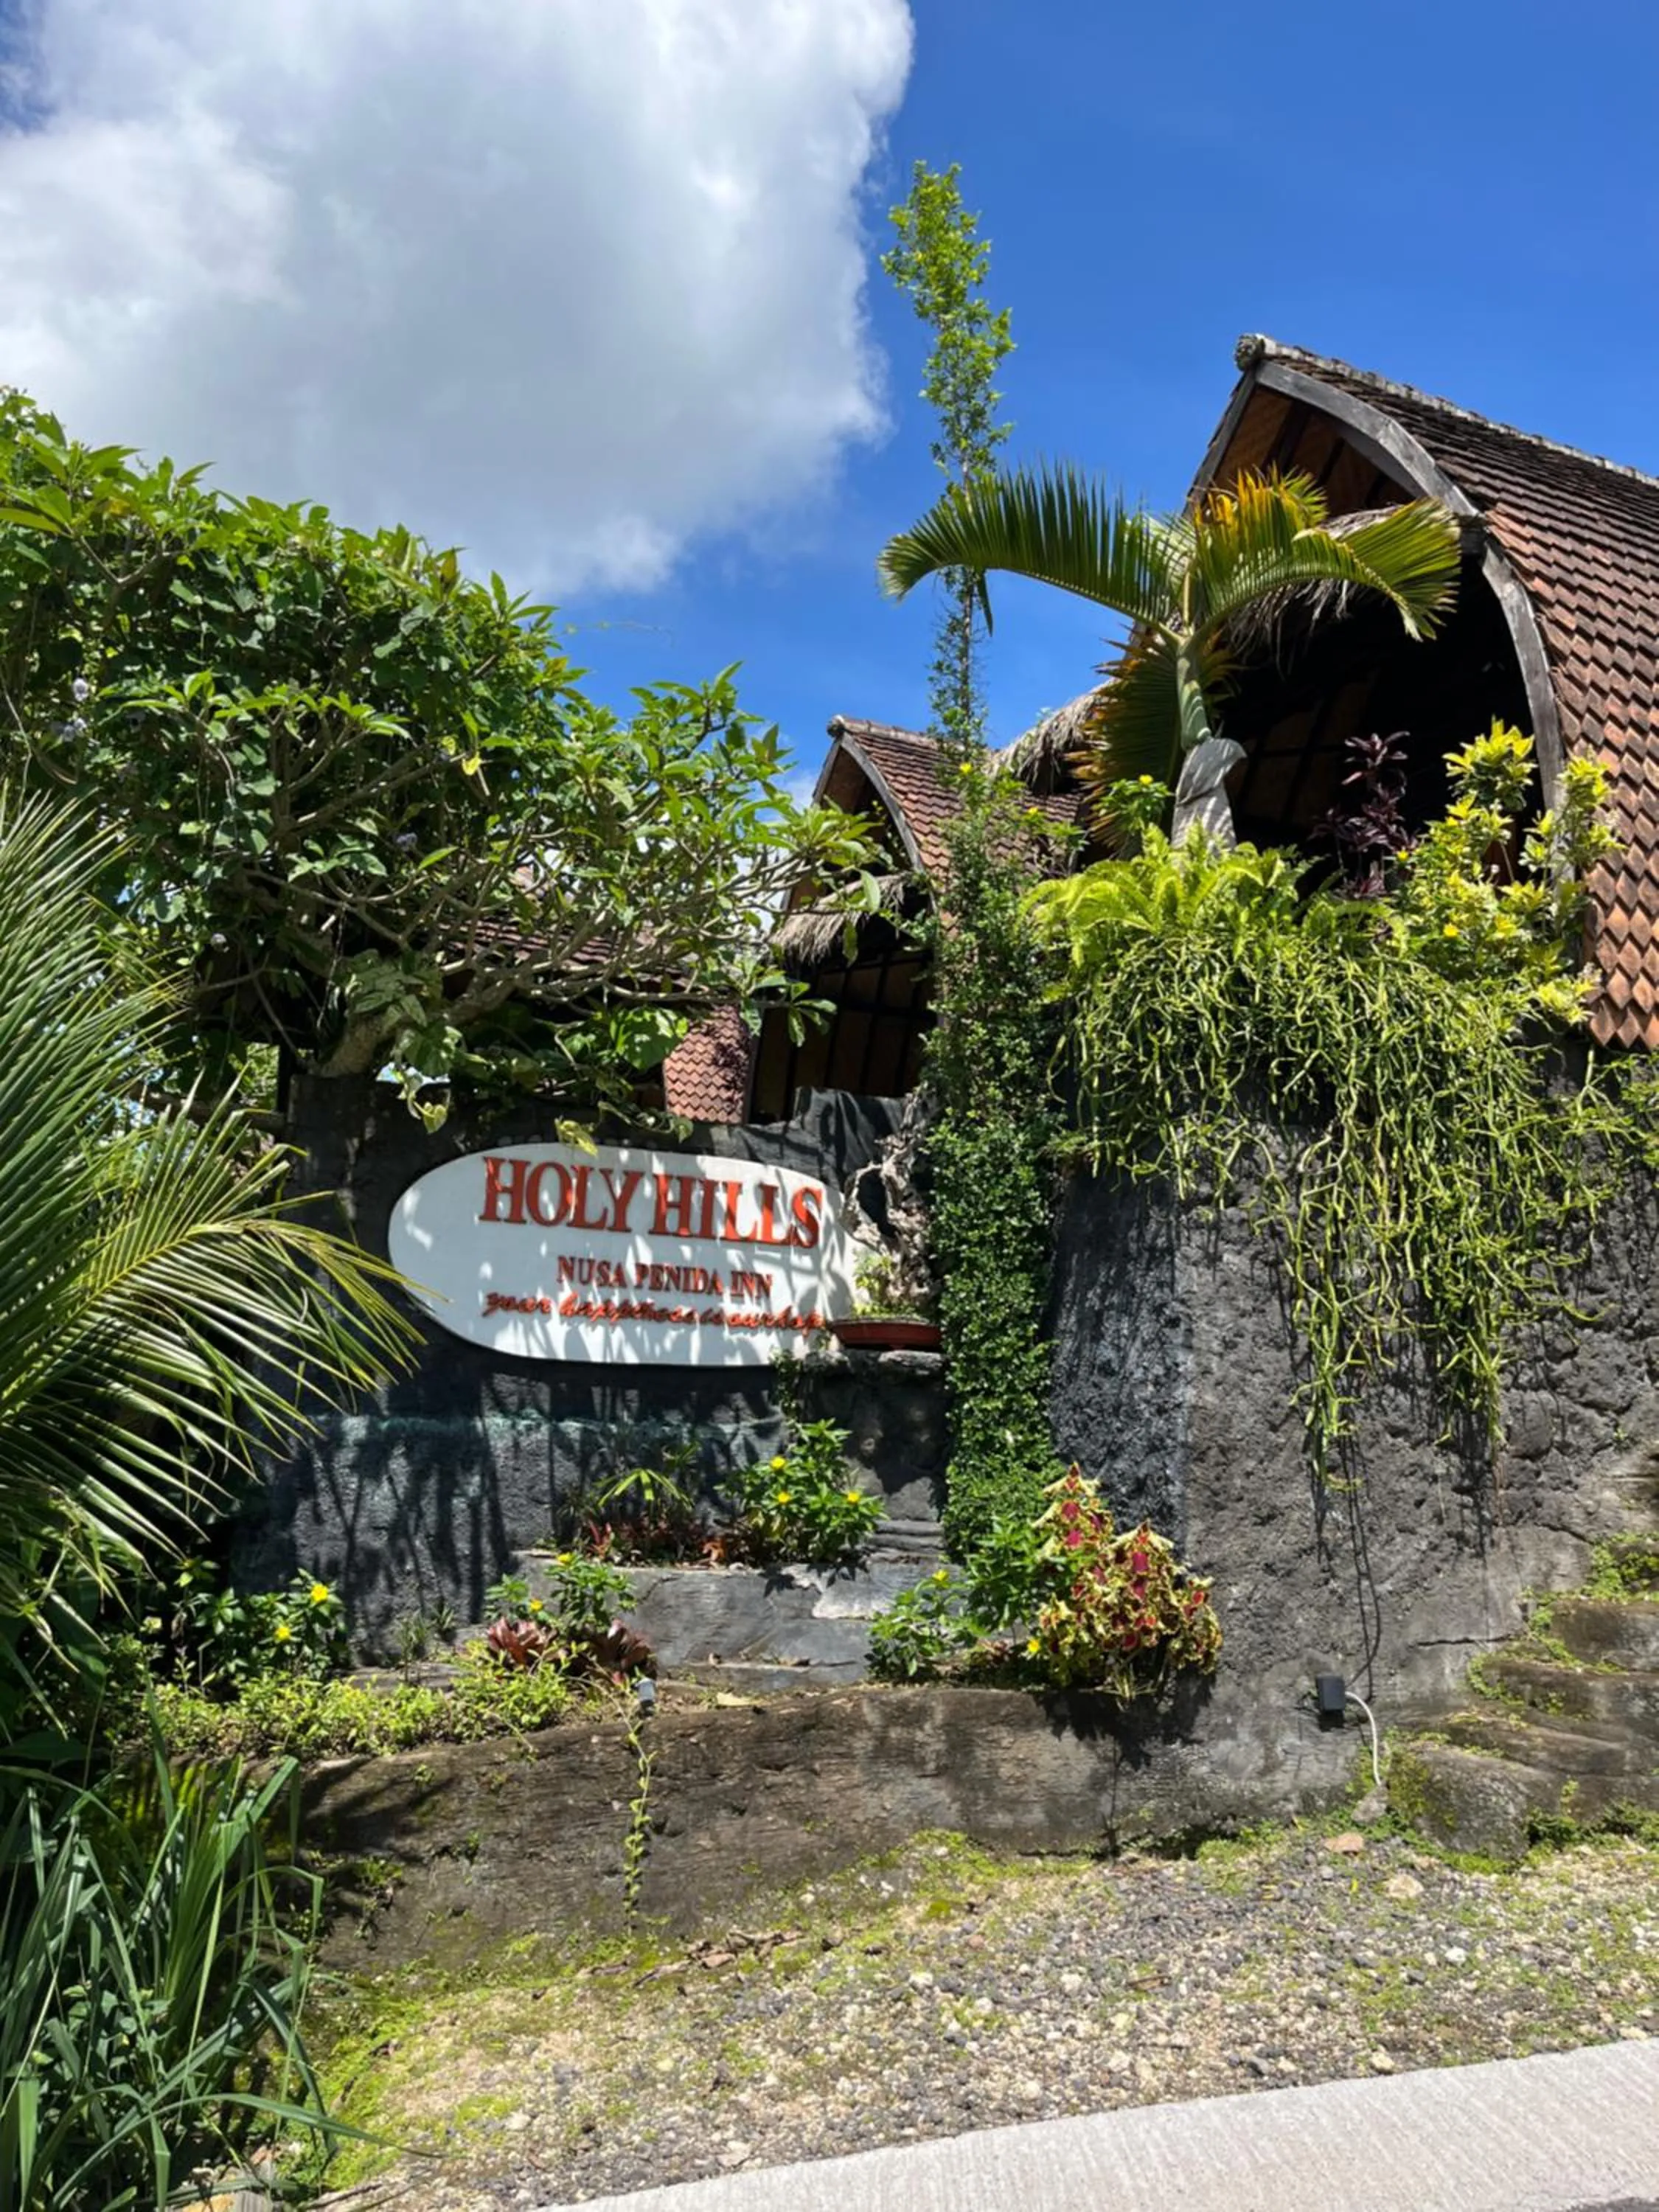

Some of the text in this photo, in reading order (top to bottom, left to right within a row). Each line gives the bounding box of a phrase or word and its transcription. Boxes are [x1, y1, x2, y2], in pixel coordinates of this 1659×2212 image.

[479, 1156, 823, 1248] HOLY HILLS
[557, 1255, 773, 1300] NUSA PENIDA INN
[481, 1292, 552, 1318] your
[559, 1292, 698, 1324] happiness
